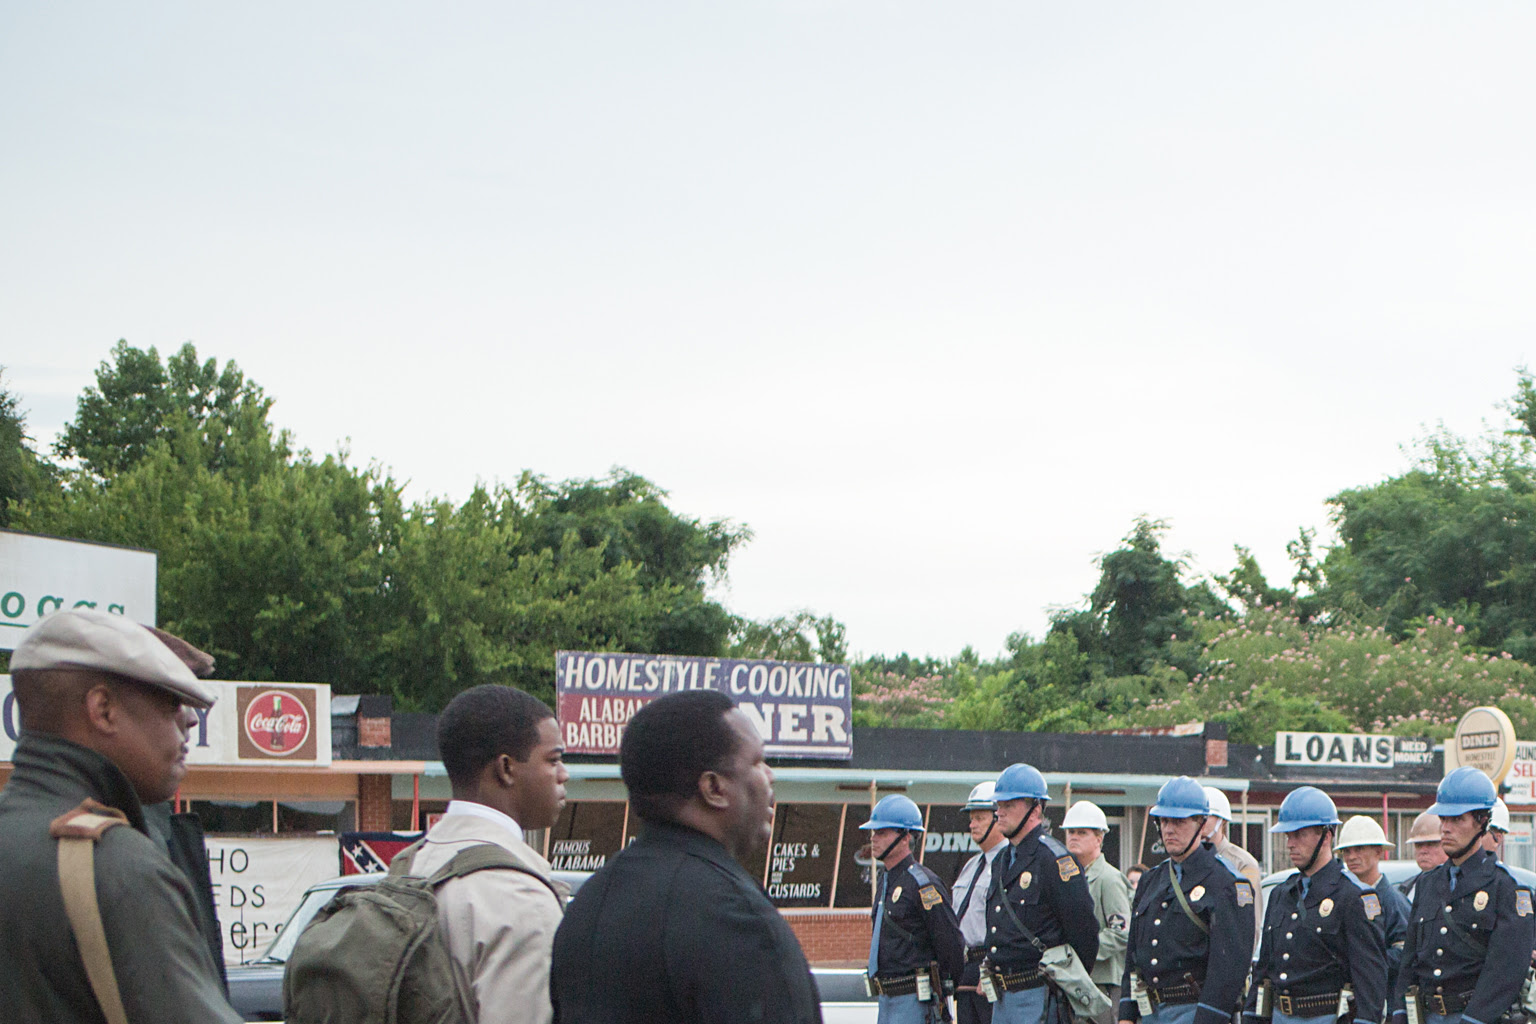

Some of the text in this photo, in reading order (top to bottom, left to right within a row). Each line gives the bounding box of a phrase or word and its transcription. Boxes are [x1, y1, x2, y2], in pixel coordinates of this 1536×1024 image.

[565, 655, 846, 699] HOMESTYLE COOKING
[250, 712, 304, 734] Coca-Cola
[1402, 741, 1427, 752] NEED
[1462, 733, 1498, 747] DINER
[1285, 734, 1392, 764] LOANS
[1395, 752, 1434, 764] MONEY?
[552, 841, 591, 855] FAMOUS
[773, 842, 820, 858] CAKES &
[551, 855, 606, 870] ALABAMA
[772, 856, 796, 872] PIES
[768, 883, 821, 899] CUSTARDS
